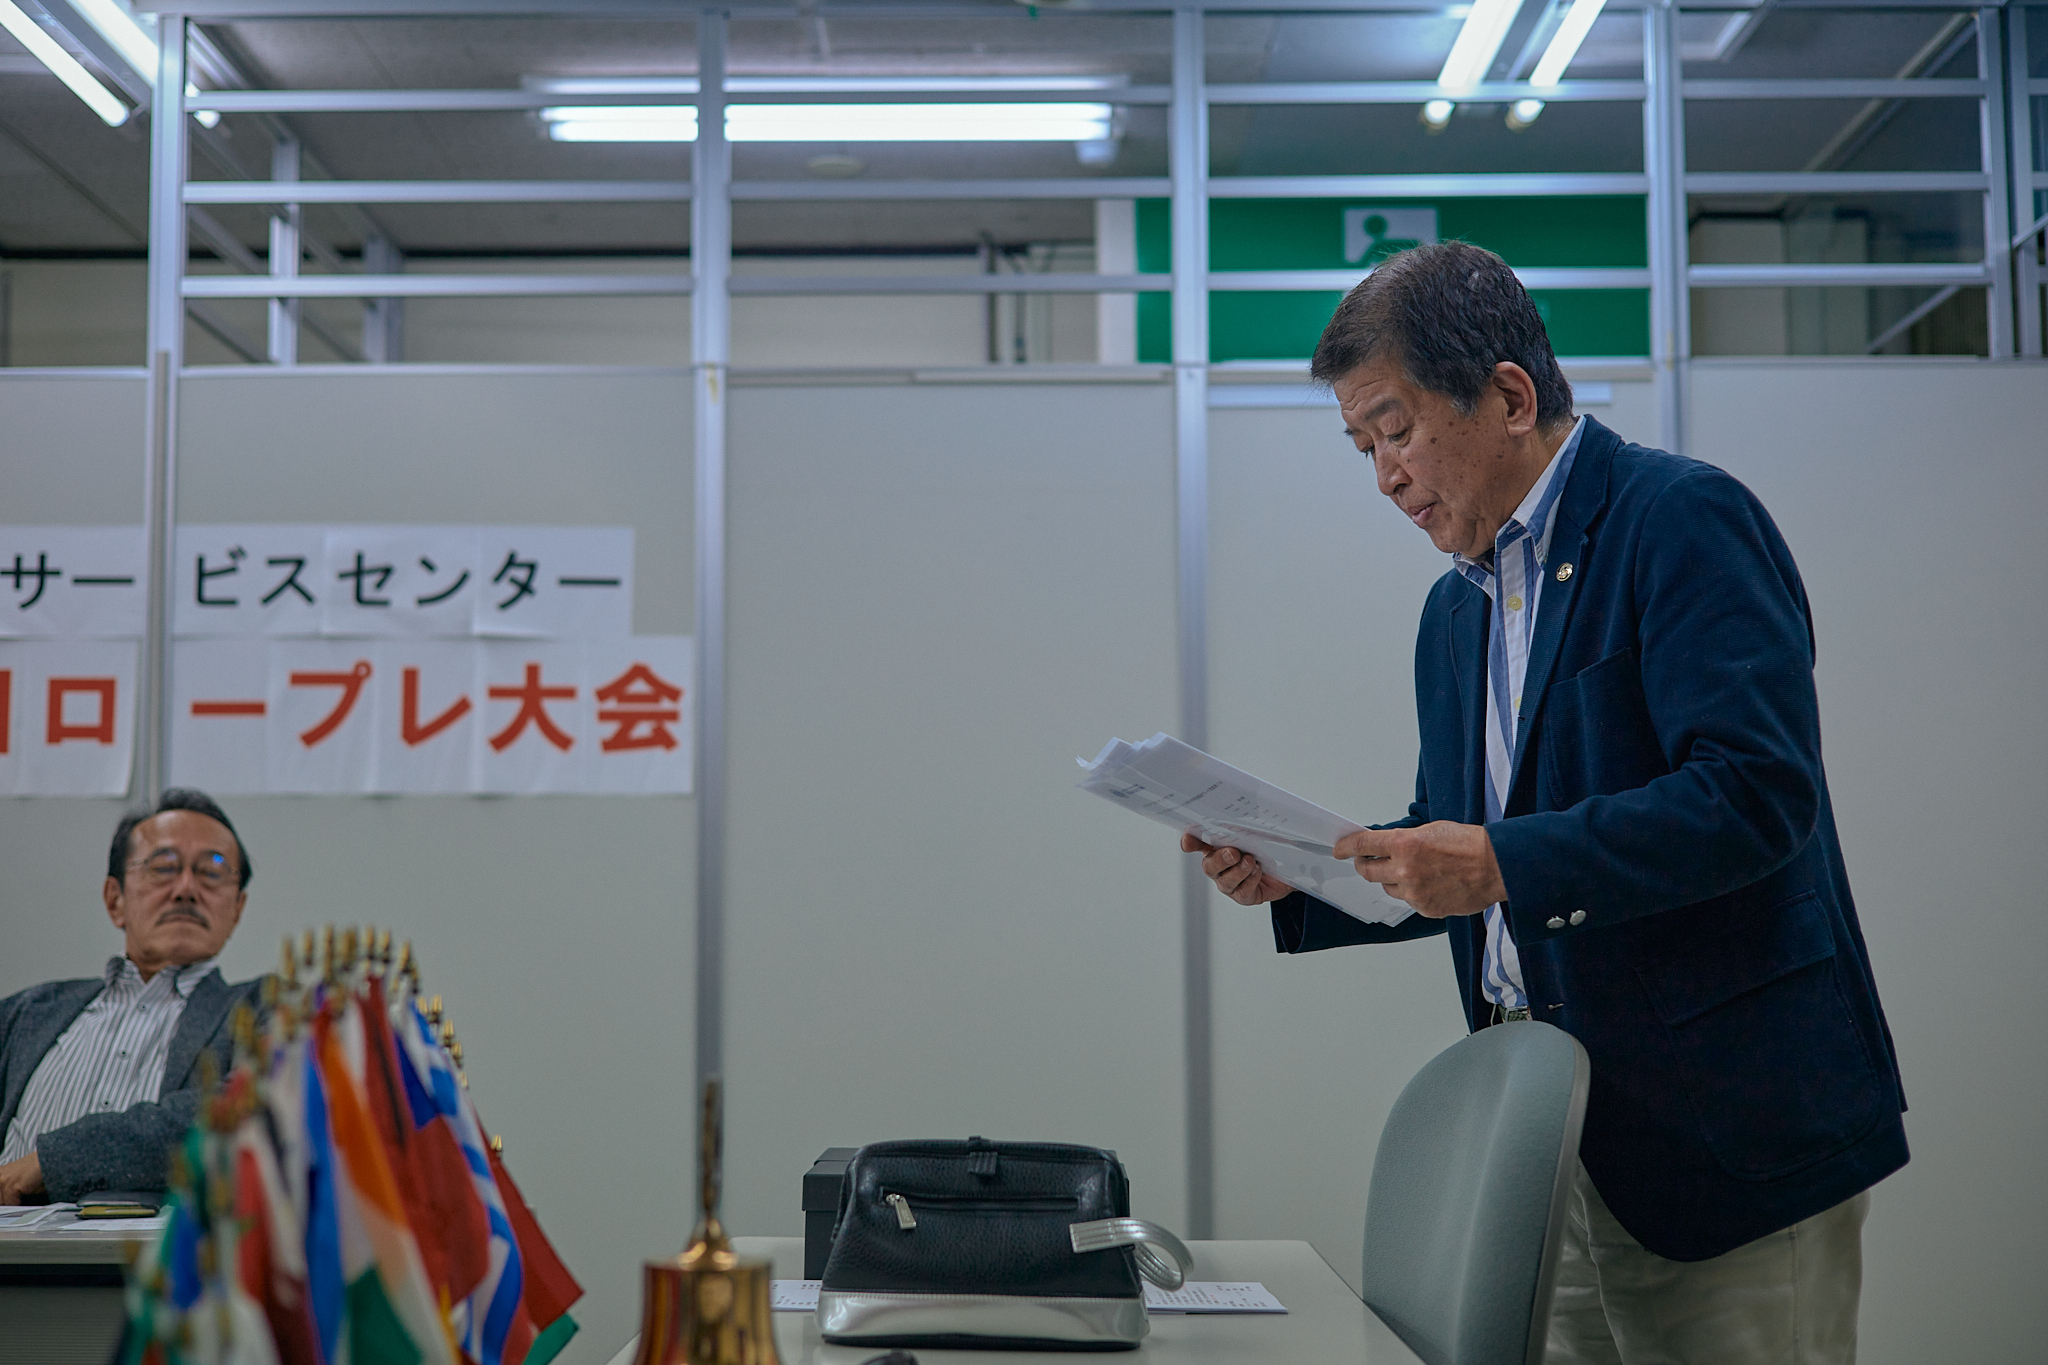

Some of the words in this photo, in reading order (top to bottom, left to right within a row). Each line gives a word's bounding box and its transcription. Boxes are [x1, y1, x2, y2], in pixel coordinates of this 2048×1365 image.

[0, 659, 684, 755] ロープレ大会
